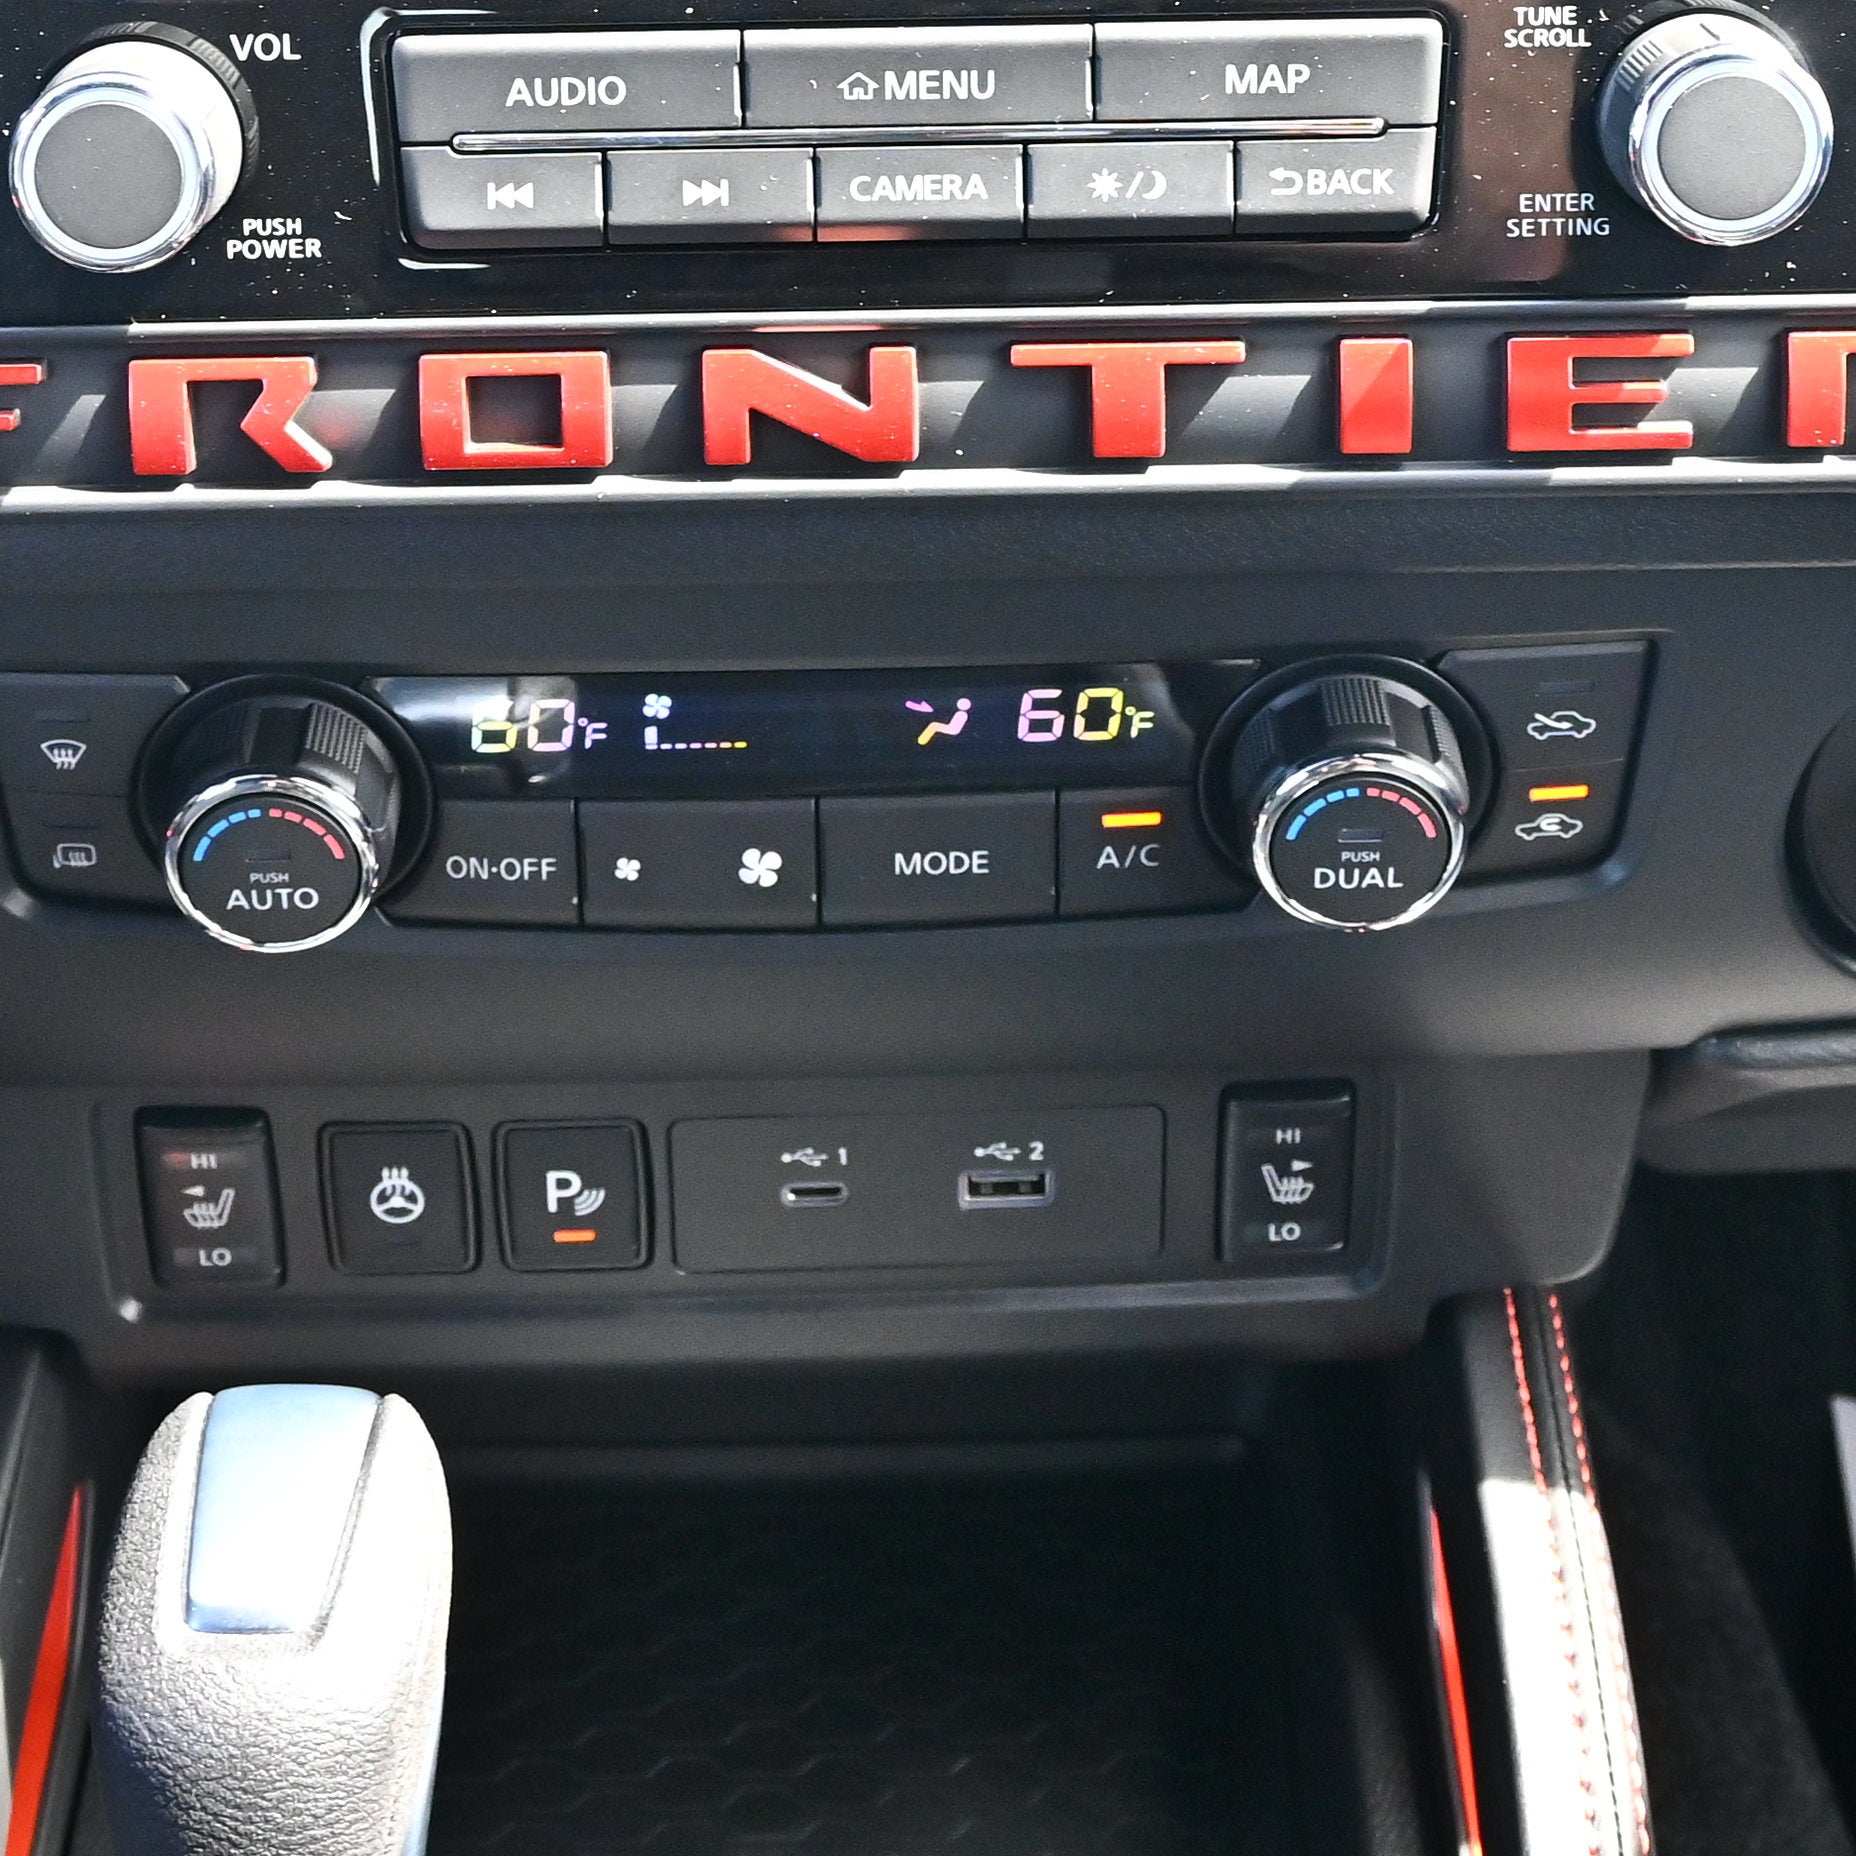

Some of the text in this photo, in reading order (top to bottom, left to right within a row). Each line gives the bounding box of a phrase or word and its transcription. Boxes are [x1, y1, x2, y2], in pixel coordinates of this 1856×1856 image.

[1512, 5, 1578, 27] TUNE
[229, 33, 301, 62] VOL
[1504, 27, 1592, 48] SCROLL
[884, 69, 996, 101] MENU
[1224, 63, 1312, 95] MAP
[505, 75, 627, 108] AUDIO
[849, 173, 988, 202] CAMERA
[1306, 167, 1394, 196] BACK
[1519, 193, 1595, 213] ENTER
[242, 217, 302, 236] PUSH
[1506, 217, 1610, 238] SETTING
[226, 238, 321, 261] POWER
[894, 850, 991, 876] MODE
[1096, 843, 1160, 870] A/C
[1341, 851, 1381, 864] PUSH
[249, 872, 289, 884] PUSH
[1314, 866, 1404, 891] DUAL
[226, 887, 319, 911] AUTO
[1275, 1127, 1301, 1144] HI
[190, 1153, 218, 1170] HI
[838, 1147, 848, 1166] 1
[1029, 1142, 1045, 1161] 2
[1268, 1223, 1301, 1242] LO
[199, 1248, 232, 1267] LO
